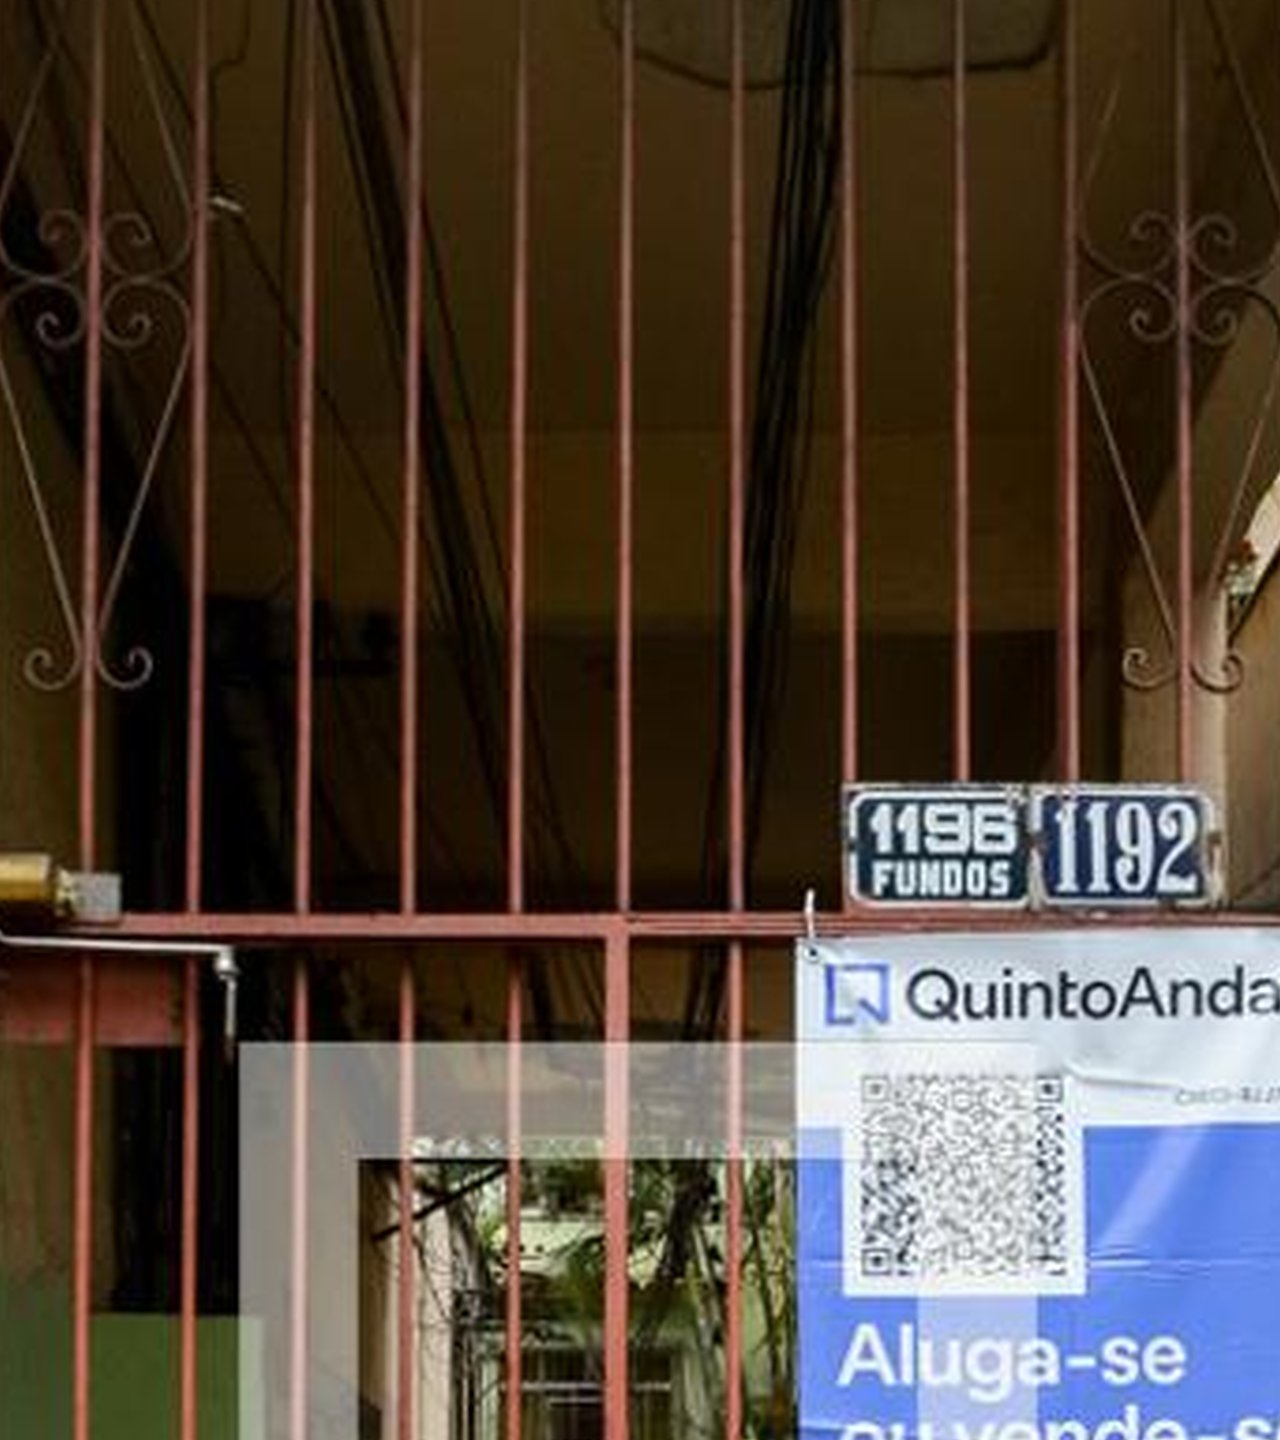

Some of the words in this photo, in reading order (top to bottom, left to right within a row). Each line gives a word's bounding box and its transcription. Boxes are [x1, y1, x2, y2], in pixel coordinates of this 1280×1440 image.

[869, 803, 1018, 855] 1196
[1055, 801, 1198, 894] 1192
[872, 860, 1011, 897] FUNDOS
[836, 1322, 1188, 1404] Aluga-se
